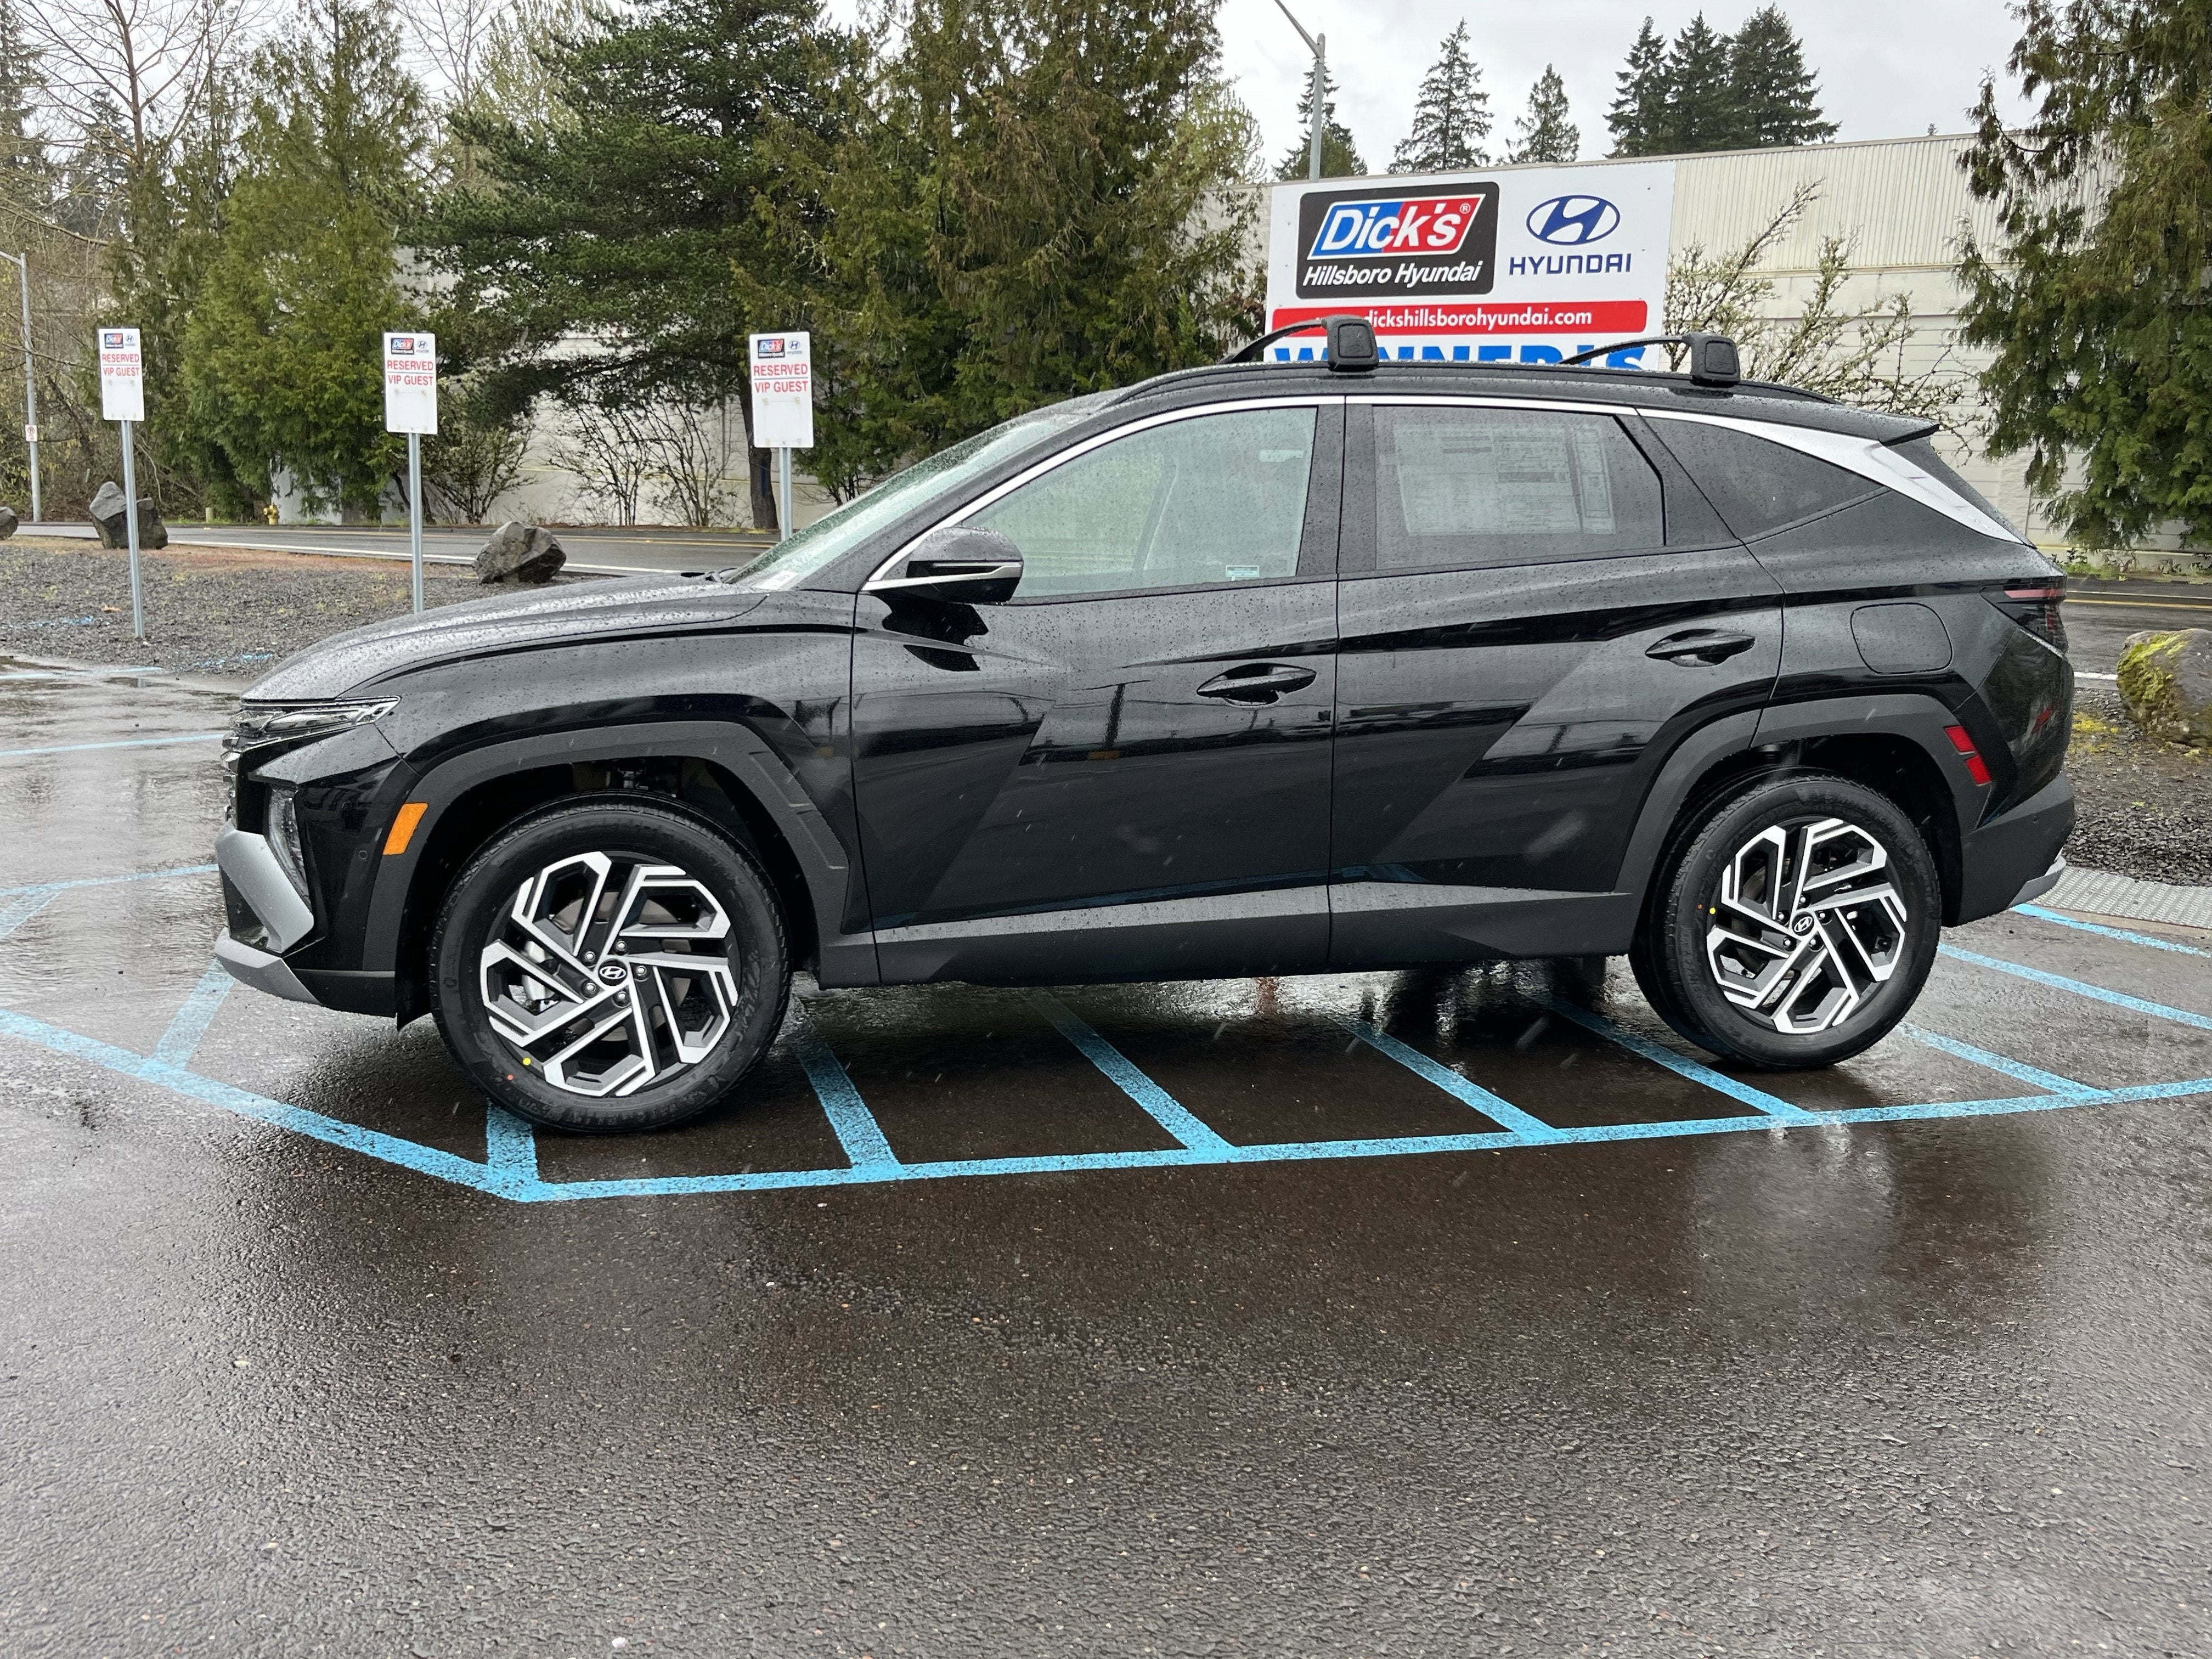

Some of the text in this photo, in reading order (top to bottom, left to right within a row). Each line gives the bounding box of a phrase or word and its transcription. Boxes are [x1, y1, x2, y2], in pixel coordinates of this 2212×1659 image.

[1509, 253, 1632, 275] HYUNDAI
[1303, 261, 1483, 288] Hillsboro Hyundai
[1316, 306, 1592, 331] dickshillsborohyundai.com
[102, 354, 139, 363] RESERVED
[103, 367, 139, 376] VIP GUEST
[387, 360, 433, 371] RESERVED
[753, 364, 808, 376] RESERVED
[388, 375, 433, 386] VIP GUEST
[754, 381, 809, 393] VIP GUEST
